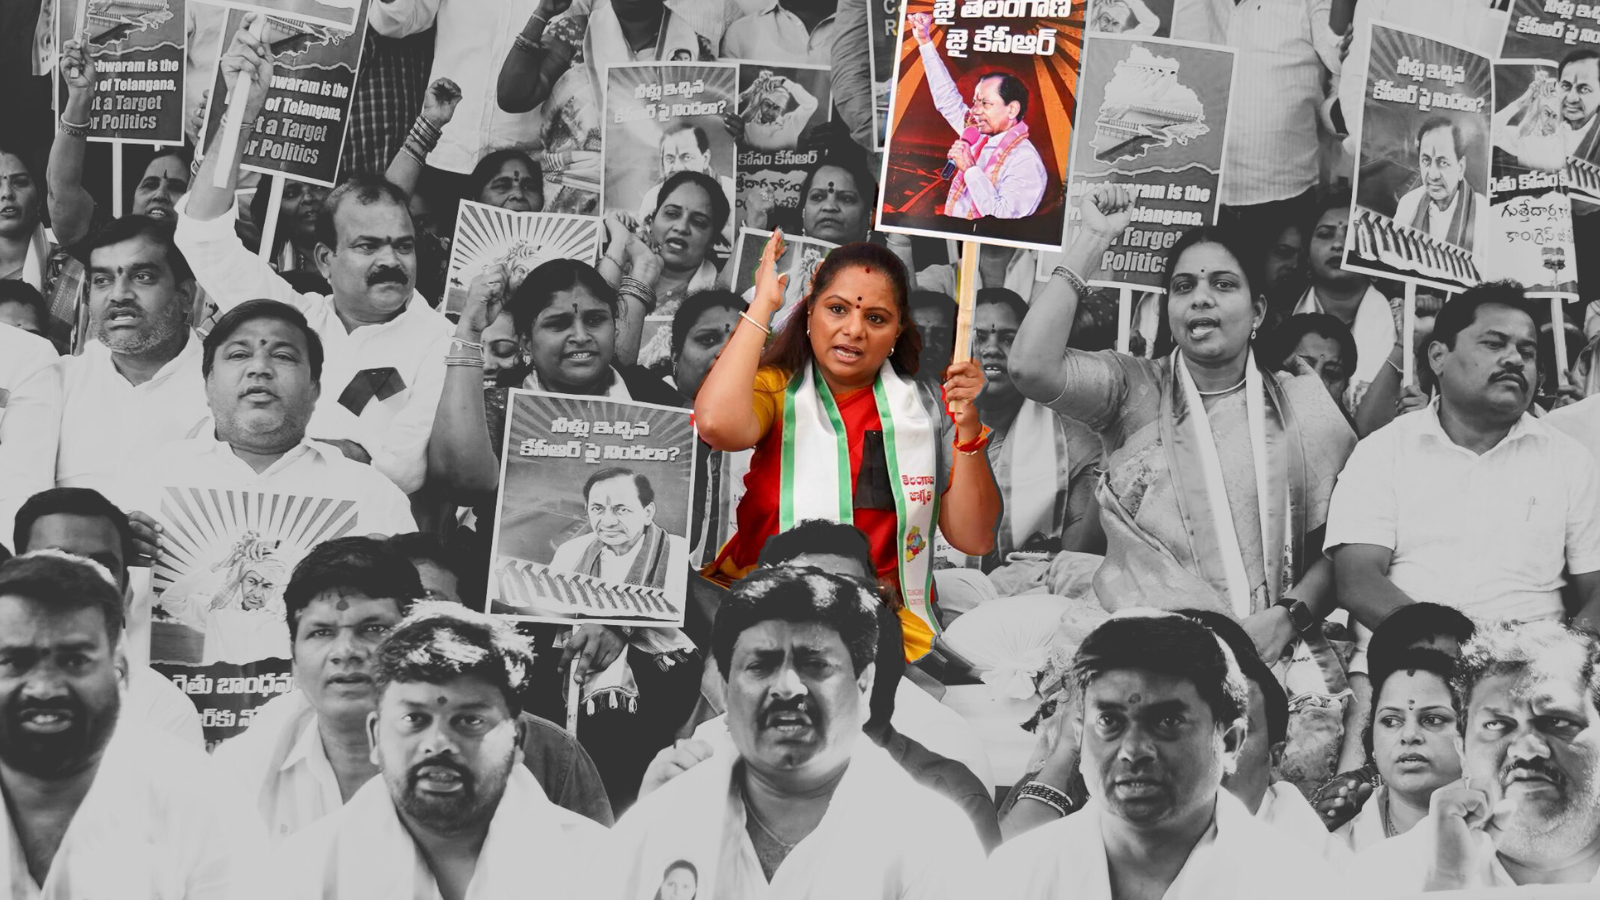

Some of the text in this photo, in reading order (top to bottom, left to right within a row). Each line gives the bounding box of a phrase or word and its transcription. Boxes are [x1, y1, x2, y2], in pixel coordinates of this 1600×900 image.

[1516, 15, 1565, 38] కేసీఆర్
[1564, 24, 1579, 45] పై
[946, 25, 1057, 58] జై కేసీఆర్
[147, 59, 158, 72] is
[160, 59, 179, 72] the
[1397, 55, 1466, 87] నీళ్లు ఇచ్చిన
[100, 78, 112, 91] of
[114, 78, 176, 92] Telangana,
[320, 80, 332, 96] is
[332, 83, 349, 98] the
[663, 79, 705, 99] ఇచ్చిన
[1373, 79, 1485, 113] కేసీఆర్ పై నిందలా?
[103, 97, 112, 110] a
[116, 95, 161, 111] Target
[265, 97, 342, 122] of Telangana,
[658, 103, 670, 122] పై
[672, 100, 727, 117] నిందలా?
[102, 114, 156, 129] Politics
[266, 119, 278, 135] a
[282, 118, 327, 142] Target
[260, 139, 319, 164] Politics
[738, 150, 818, 166] కోసం కేసీఆర్
[1518, 170, 1558, 190] కోసం
[1167, 183, 1183, 200] is
[1184, 185, 1210, 202] the
[551, 417, 650, 440] నీళ్లు ఇచ్చిన
[520, 438, 680, 464] కేసీఆర్ పై నిందలా?
